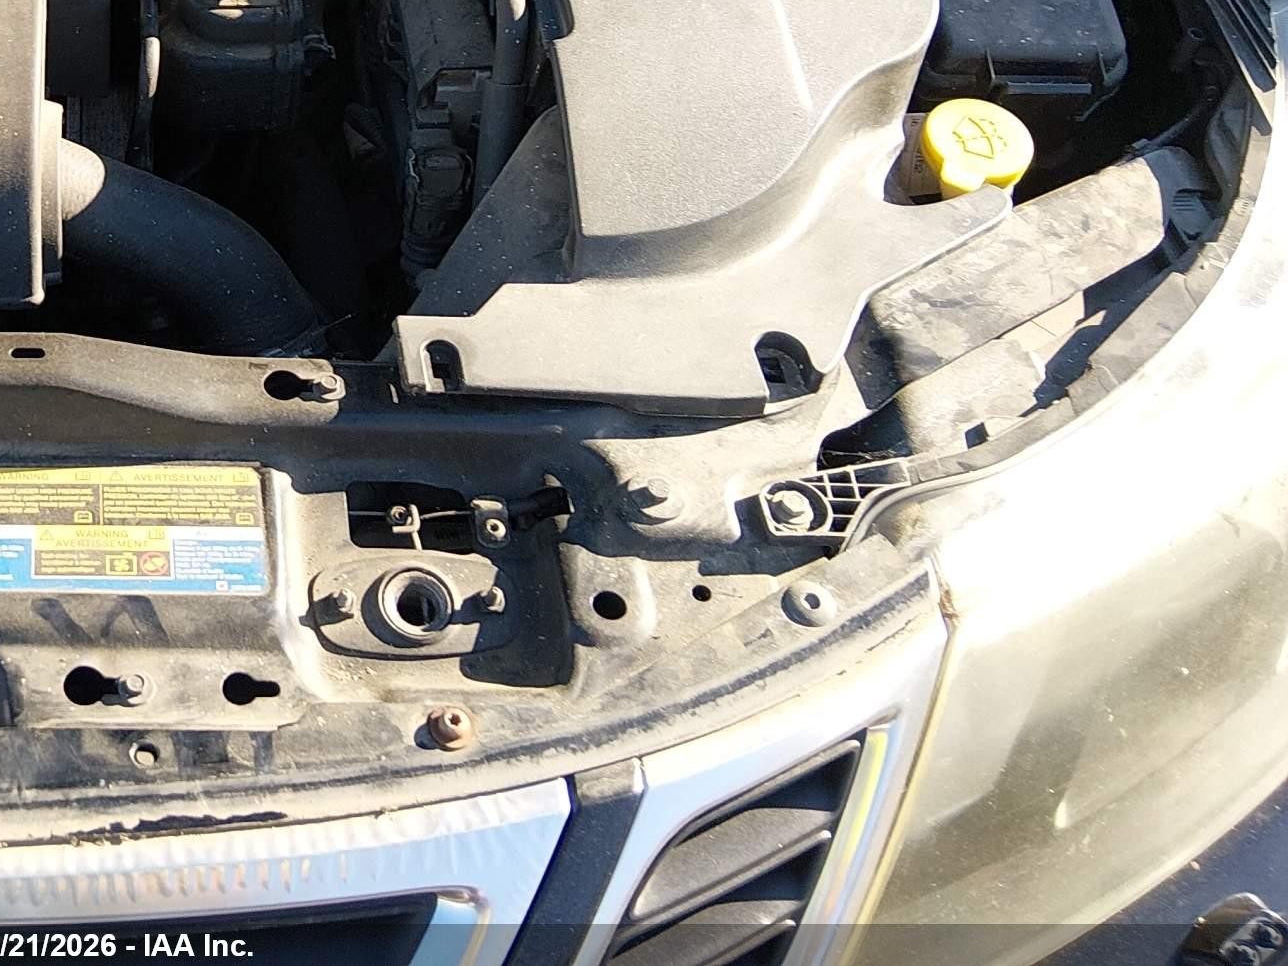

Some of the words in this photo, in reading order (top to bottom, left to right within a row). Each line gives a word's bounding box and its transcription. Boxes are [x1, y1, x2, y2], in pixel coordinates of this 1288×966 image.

[133, 473, 224, 482] AVERTISSEMENT
[75, 529, 129, 538] WARNING
[55, 538, 149, 548] AVERTISSEMENT
